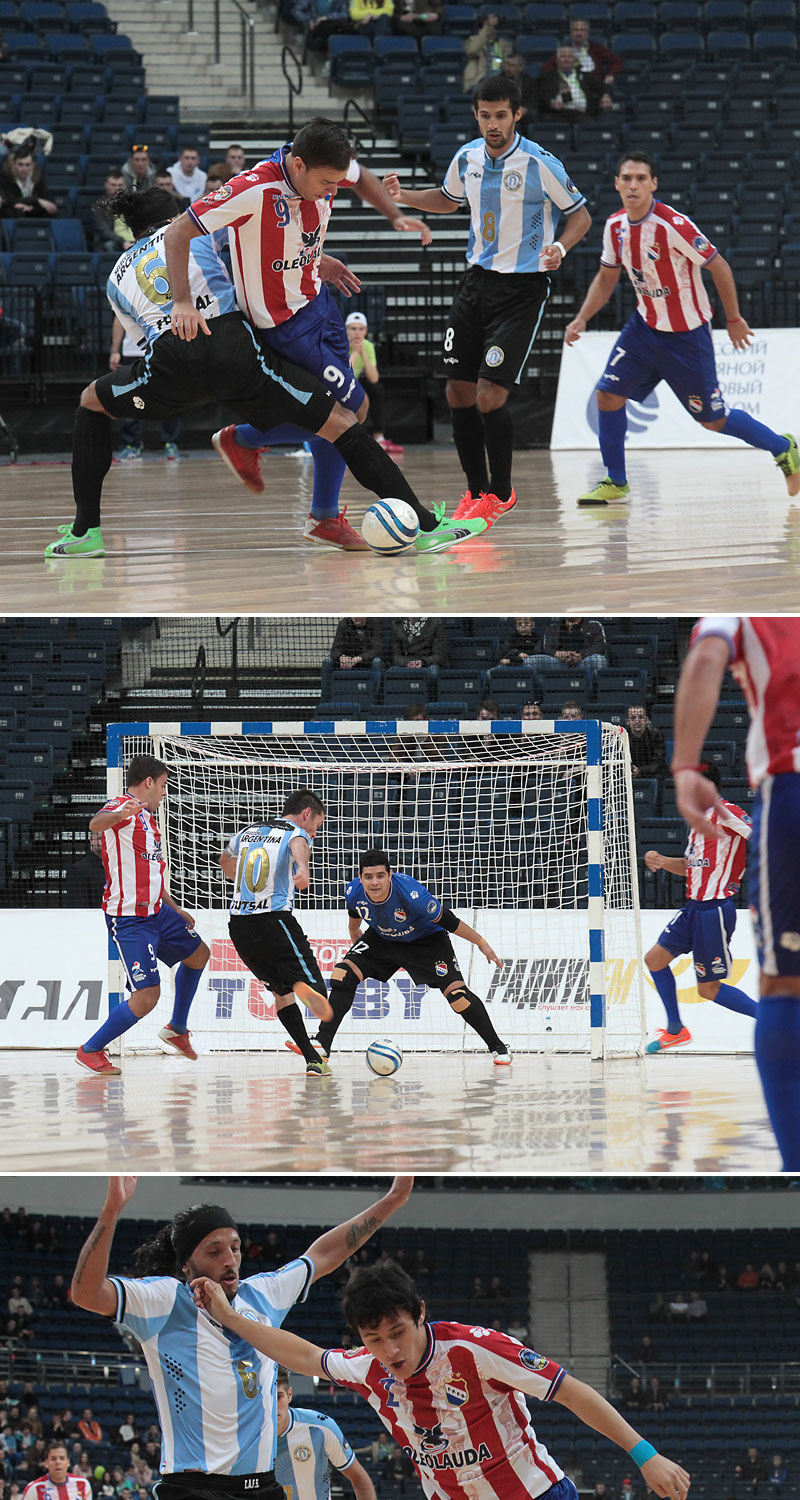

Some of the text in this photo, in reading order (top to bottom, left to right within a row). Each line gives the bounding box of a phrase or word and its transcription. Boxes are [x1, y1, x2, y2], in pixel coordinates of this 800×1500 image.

[273, 198, 291, 228] 9
[483, 211, 496, 242] 8
[135, 250, 174, 305] 6
[444, 327, 455, 352] 8
[610, 346, 626, 366] 7
[323, 364, 345, 388] 9
[236, 846, 270, 894] 10
[147, 943, 155, 960] 9
[237, 1360, 259, 1399] 6
[379, 1378, 400, 1408] 2
